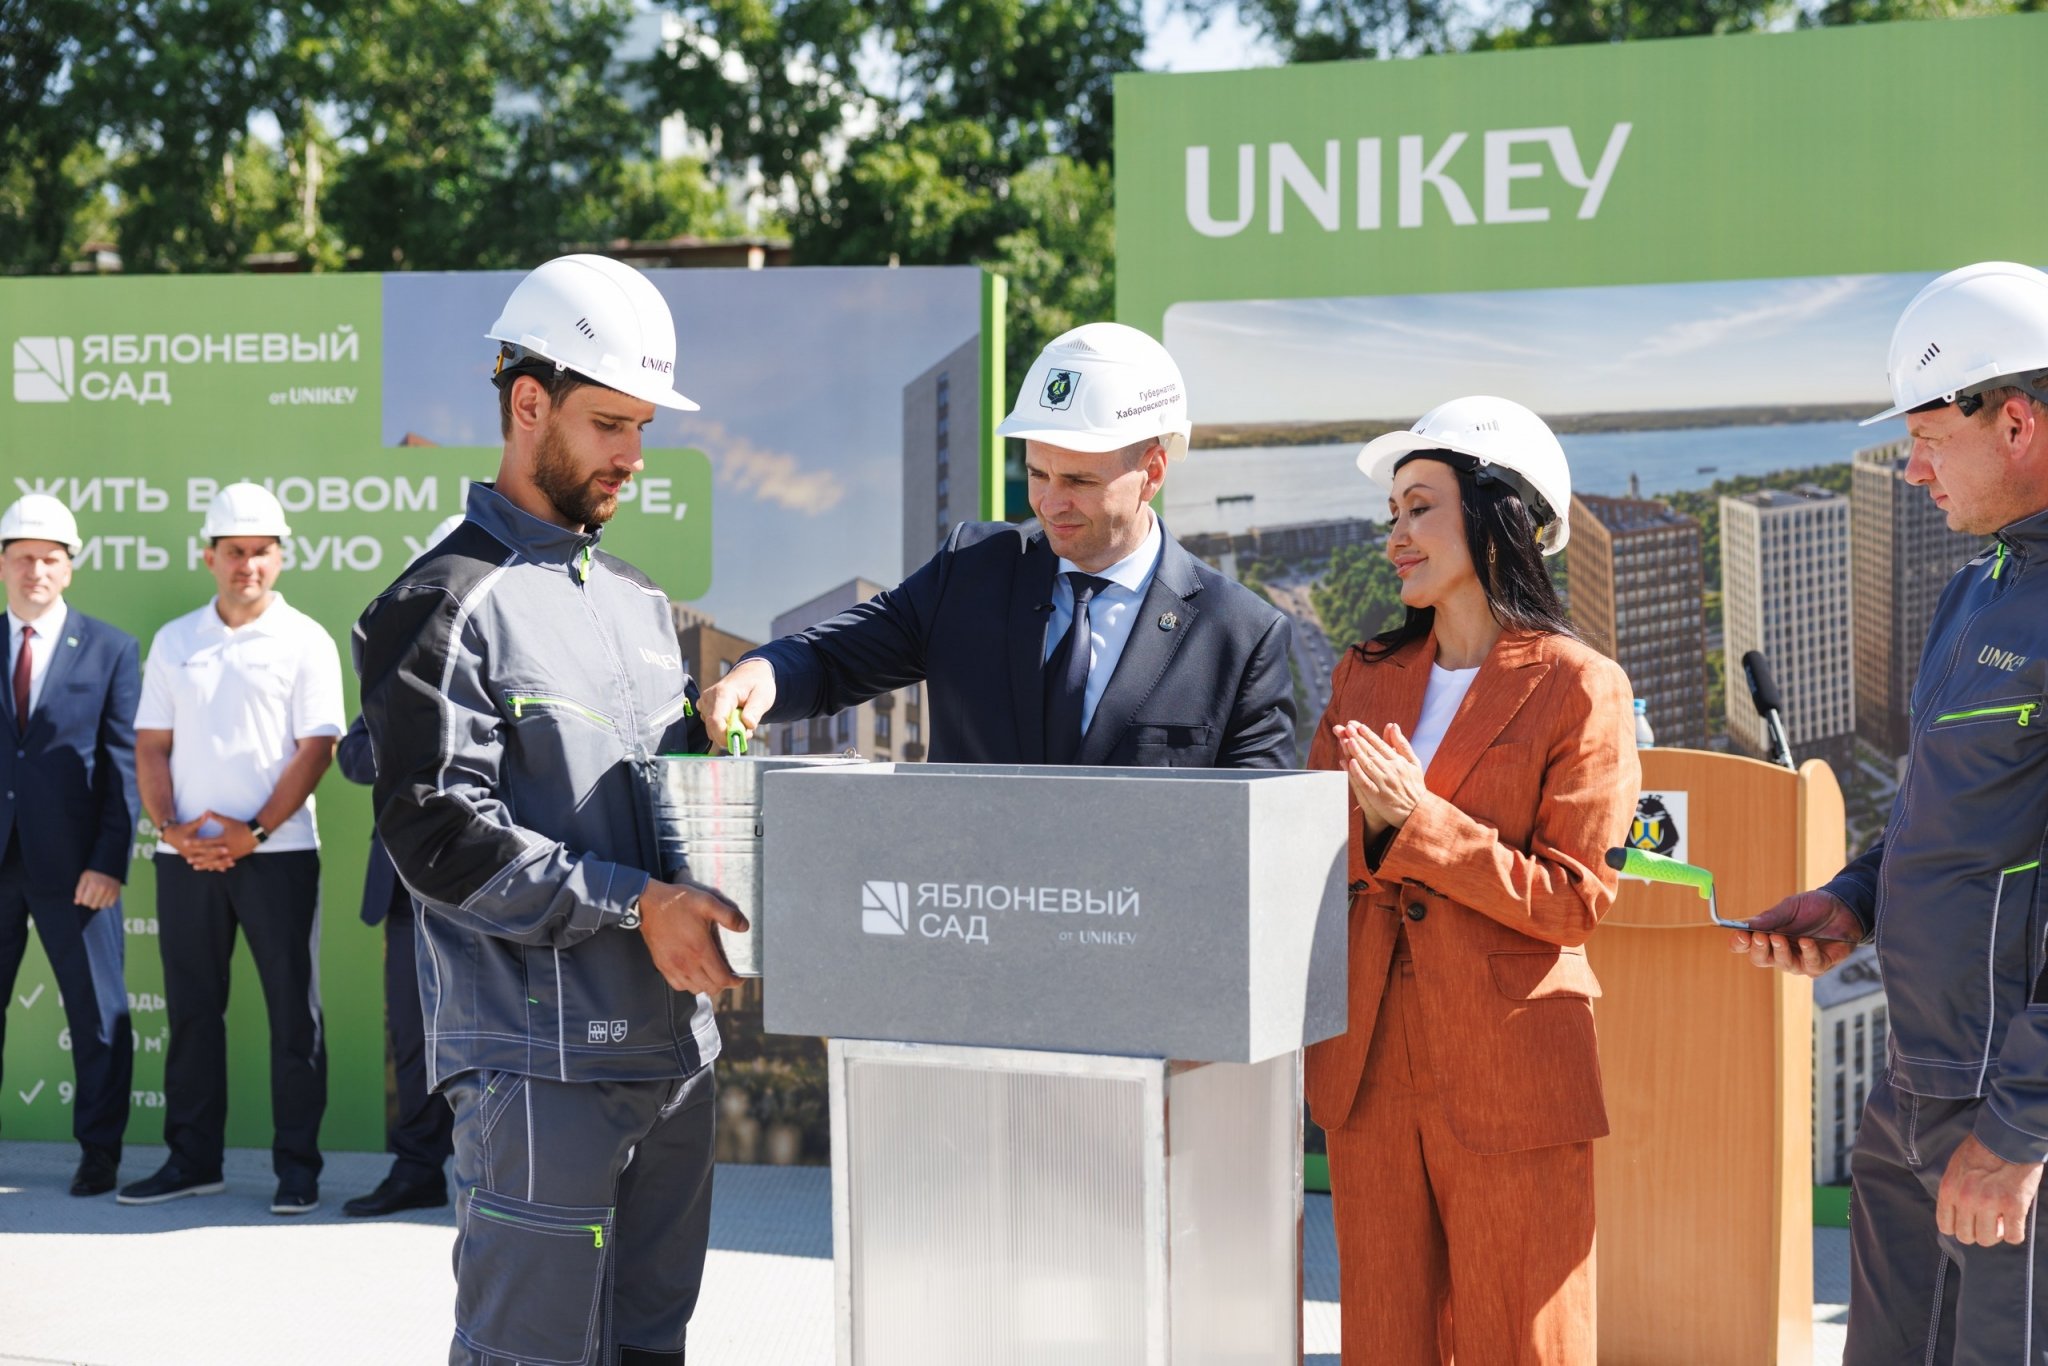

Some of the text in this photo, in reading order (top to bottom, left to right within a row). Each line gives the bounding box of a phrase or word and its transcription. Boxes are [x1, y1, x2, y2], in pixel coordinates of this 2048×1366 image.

[1185, 121, 1633, 238] UNIKEY
[81, 324, 359, 364] ЯБЛОНЕВЫЙ
[80, 371, 172, 405] САД
[269, 387, 358, 405] от UNIKEY
[1140, 383, 1176, 402] Губернатор
[1116, 398, 1168, 420] Хабаровского
[241, 475, 438, 513] ОВОМ
[72, 535, 170, 572] ИТЬ
[917, 882, 1140, 916] ЯБЛОНЕВЫЙ
[918, 913, 990, 946] САД
[1058, 929, 1138, 946] от UNIKEY
